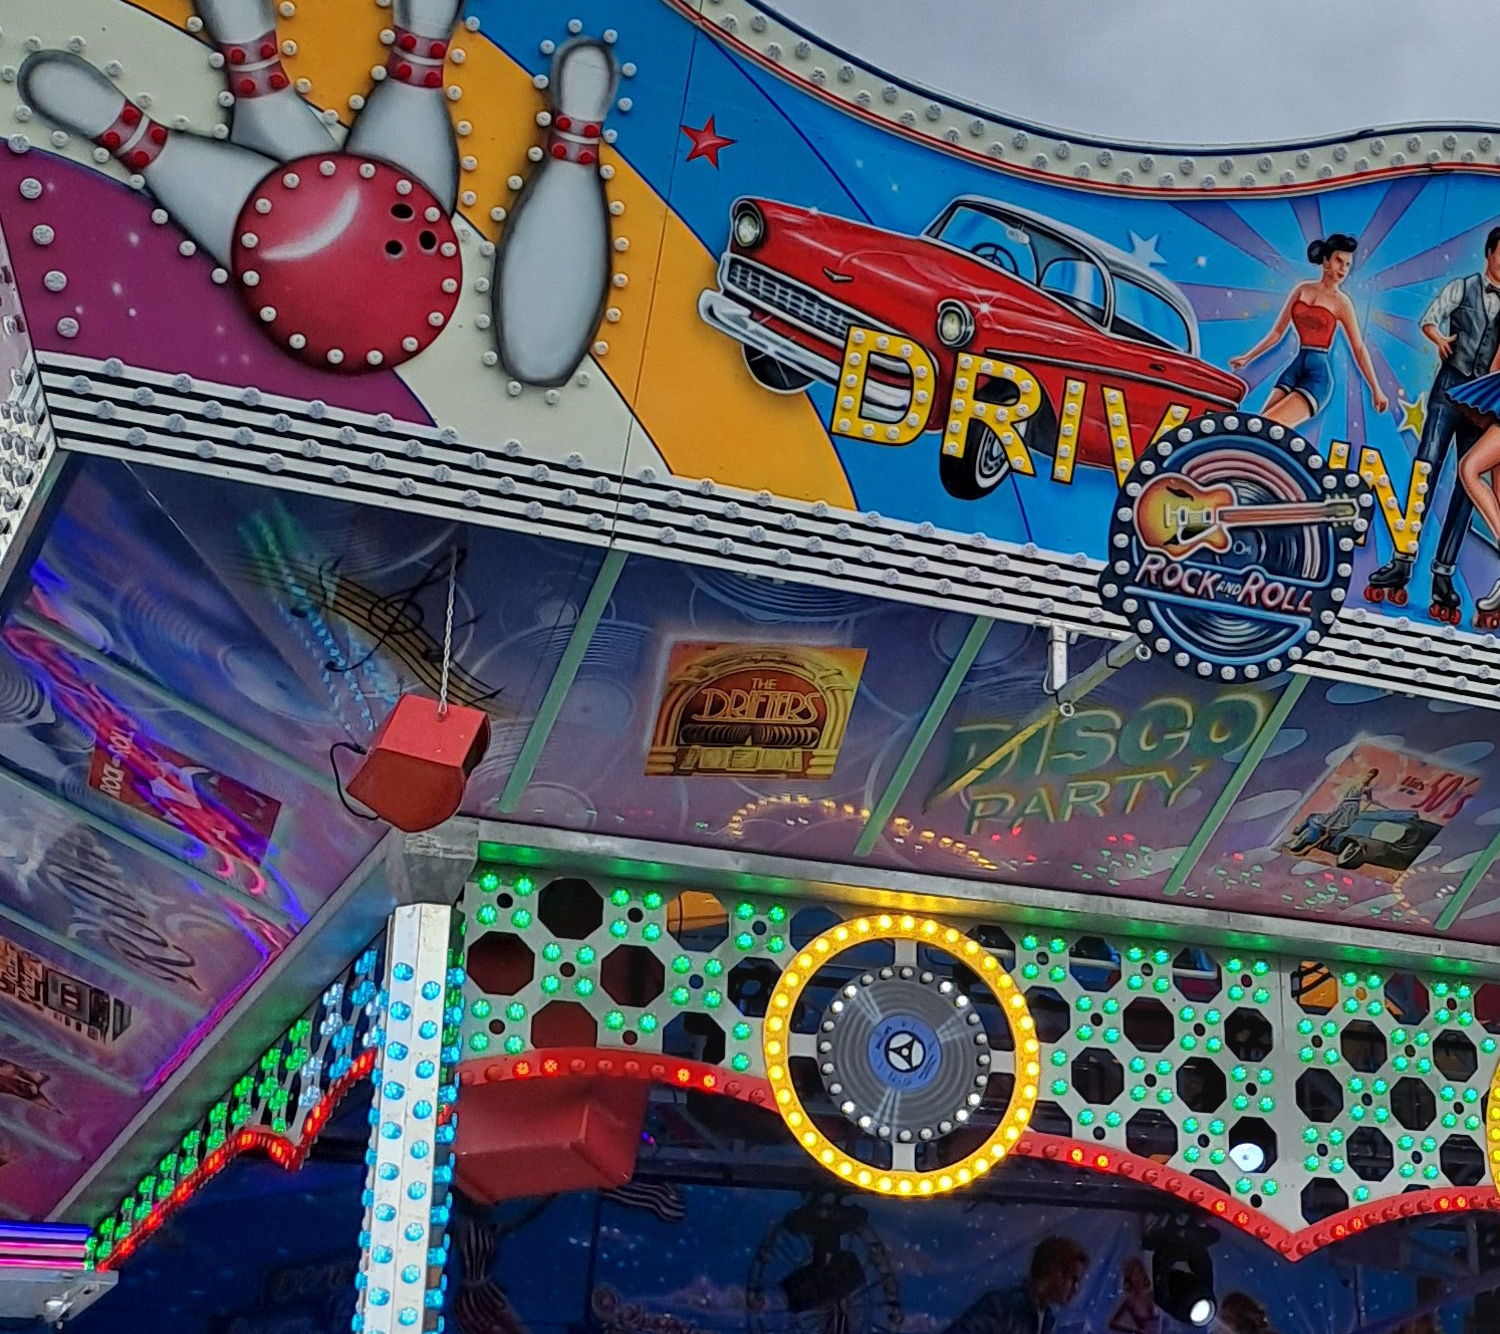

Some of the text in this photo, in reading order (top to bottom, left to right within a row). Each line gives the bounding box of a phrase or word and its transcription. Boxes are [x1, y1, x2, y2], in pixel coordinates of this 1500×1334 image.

[1134, 554, 1314, 614] ROCK AND ROLL
[691, 687, 821, 724] DRIFTERS
[751, 677, 777, 690] THE
[945, 690, 1266, 786] DISCO
[965, 764, 1205, 836] PARTY
